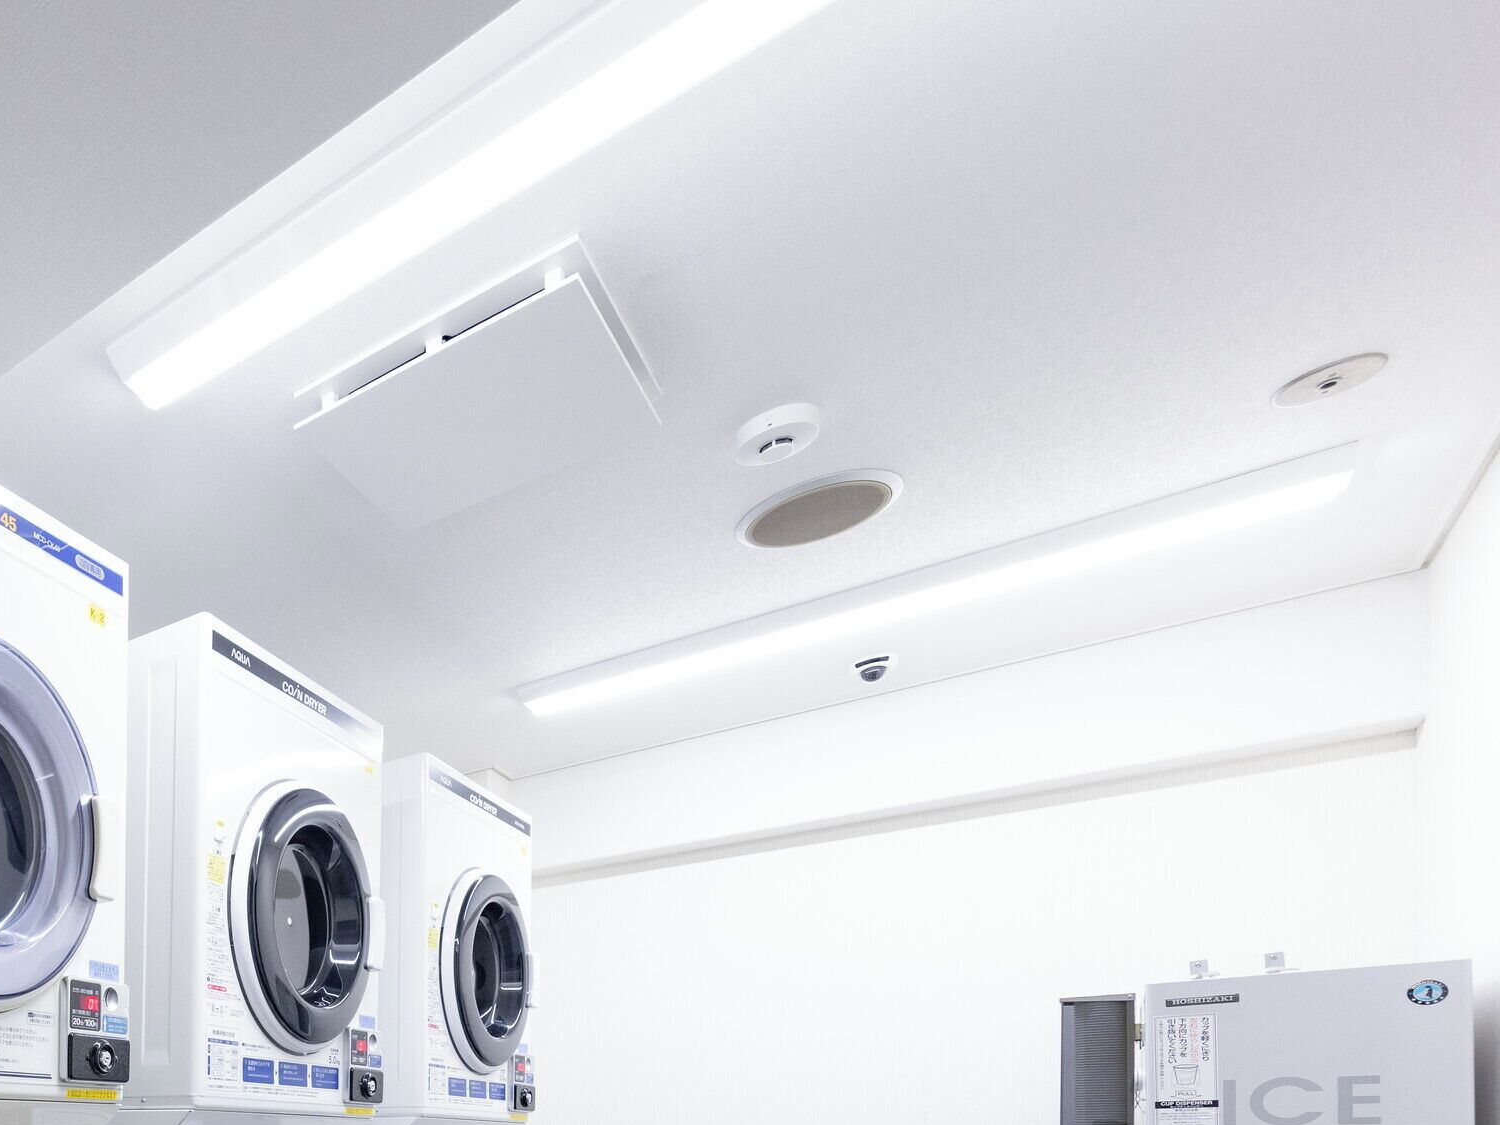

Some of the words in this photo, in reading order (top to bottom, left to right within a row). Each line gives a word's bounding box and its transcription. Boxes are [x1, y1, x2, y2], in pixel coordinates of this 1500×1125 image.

[0, 512, 18, 532] 45
[231, 648, 251, 668] AQUA
[304, 693, 327, 716] DRYER
[1171, 995, 1234, 1006] HOSHIZAKI
